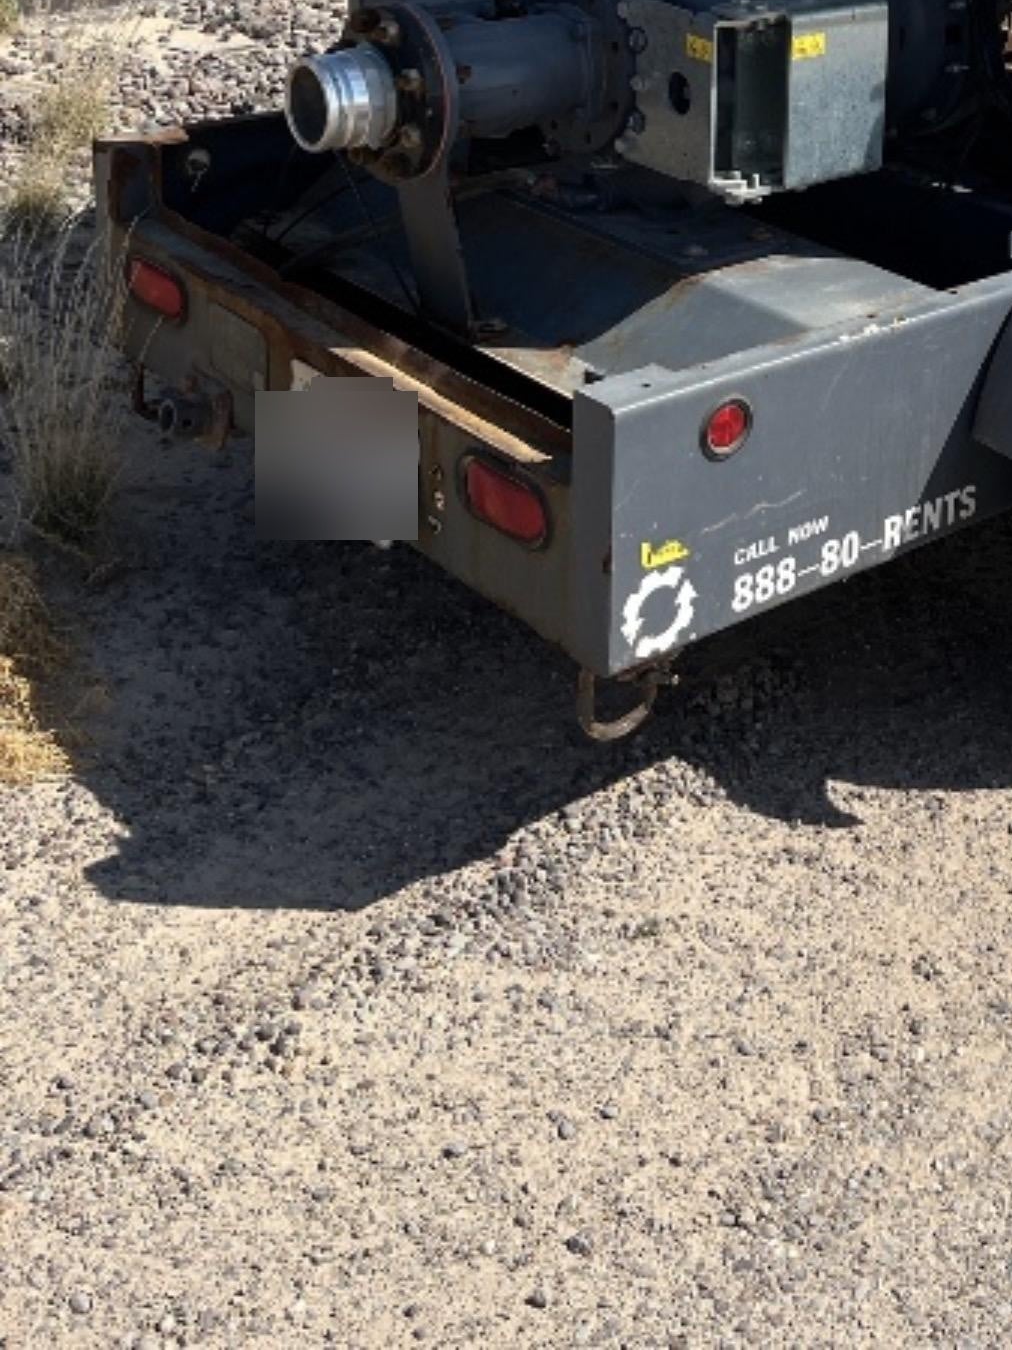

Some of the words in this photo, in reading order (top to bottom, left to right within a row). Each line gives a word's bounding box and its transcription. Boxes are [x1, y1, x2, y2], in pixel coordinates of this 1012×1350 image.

[731, 485, 976, 612] 888-80-RENTS
[734, 536, 780, 565] CALL
[788, 515, 829, 544] NOW
